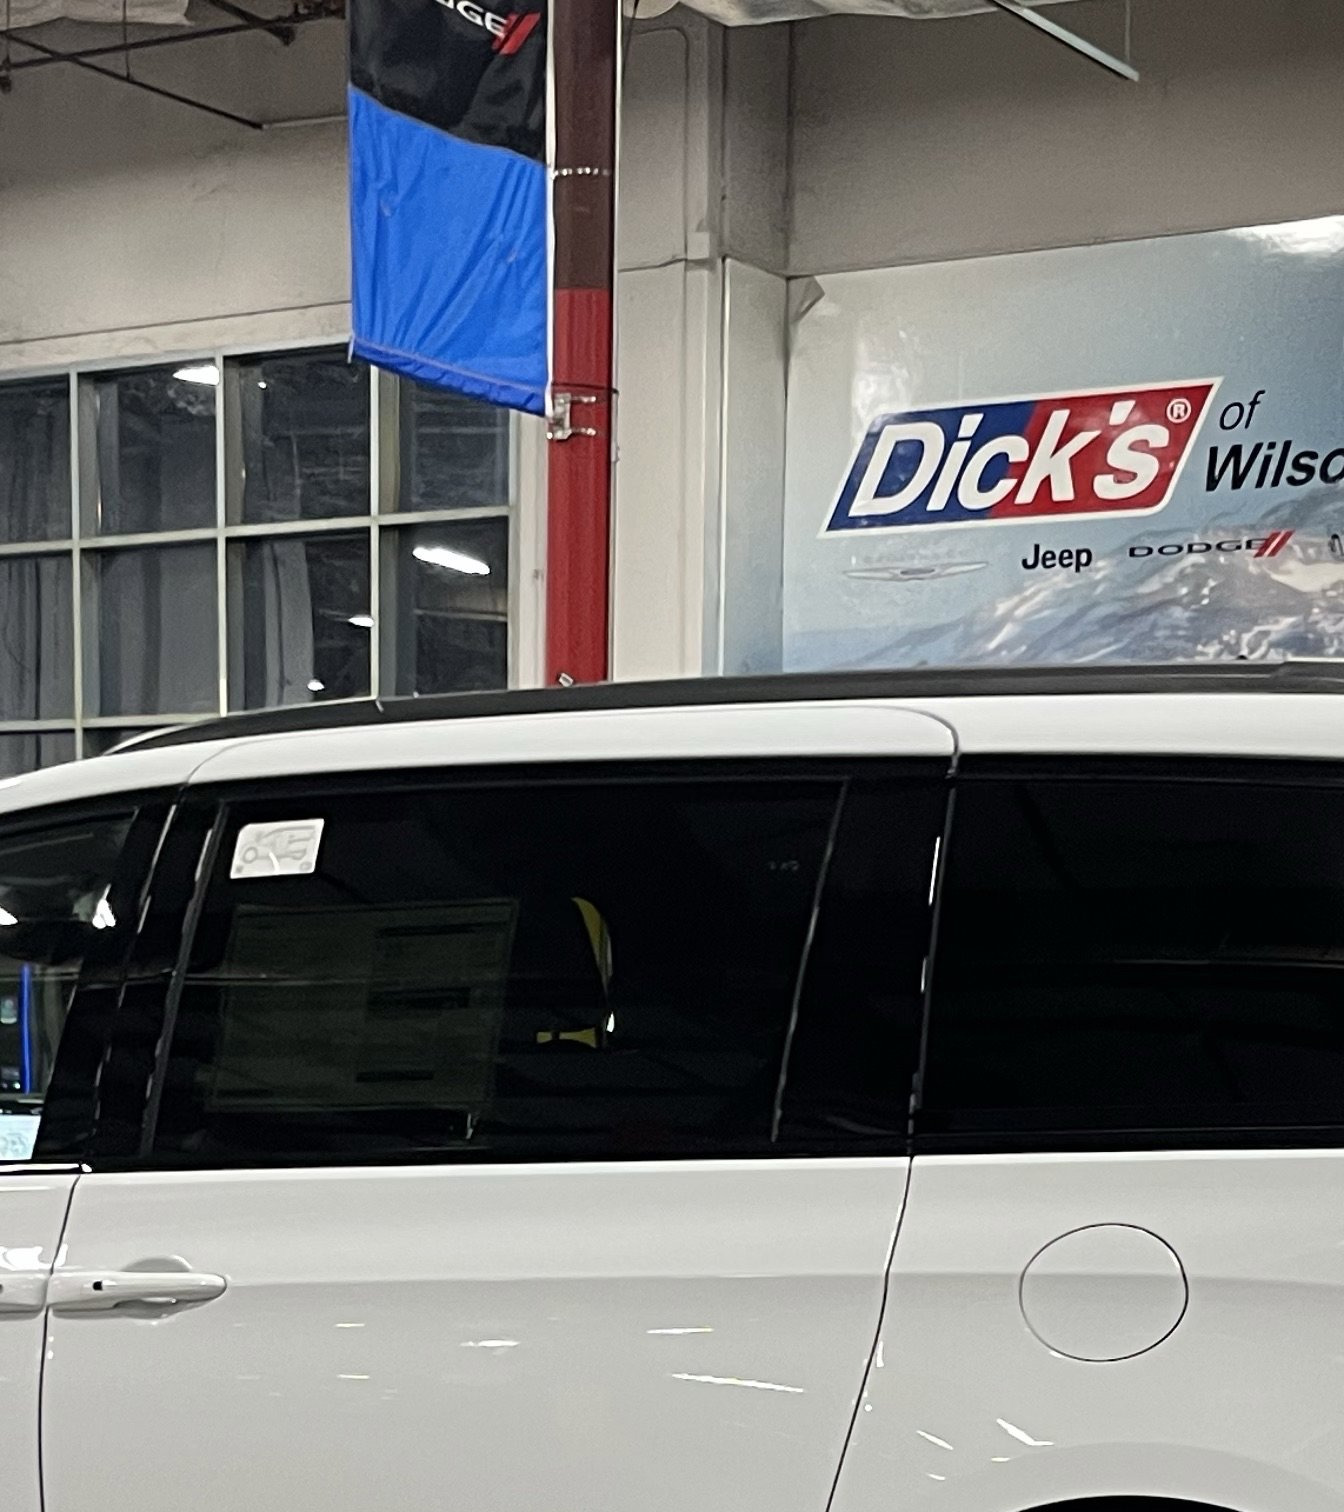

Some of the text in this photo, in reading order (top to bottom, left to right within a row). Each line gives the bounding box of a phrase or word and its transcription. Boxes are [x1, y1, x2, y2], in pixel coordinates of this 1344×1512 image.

[1219, 390, 1266, 431] of
[847, 400, 1171, 519] Dick's
[1022, 544, 1093, 573] Jeep
